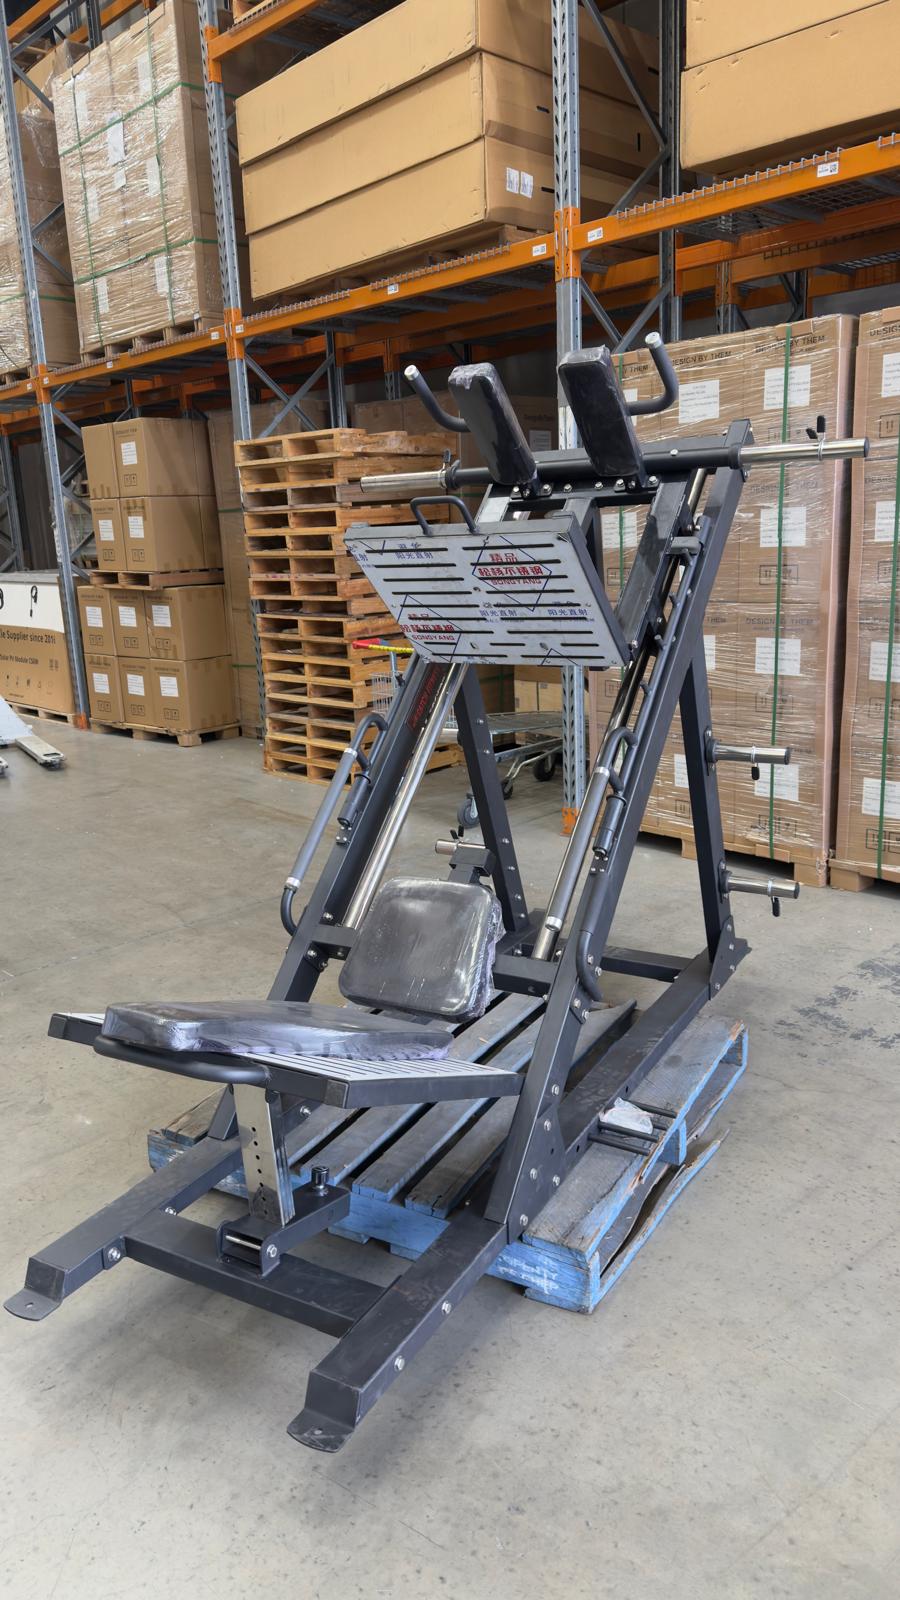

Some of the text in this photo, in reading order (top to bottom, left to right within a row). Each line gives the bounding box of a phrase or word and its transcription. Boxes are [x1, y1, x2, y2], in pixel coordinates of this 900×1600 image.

[802, 335, 825, 345] THEM
[697, 353, 708, 362] BY
[711, 350, 732, 360] THEM
[630, 364, 649, 373] THEM
[491, 578, 542, 586] SONGYANG
[6, 630, 29, 643] Supplier
[30, 634, 44, 643] since
